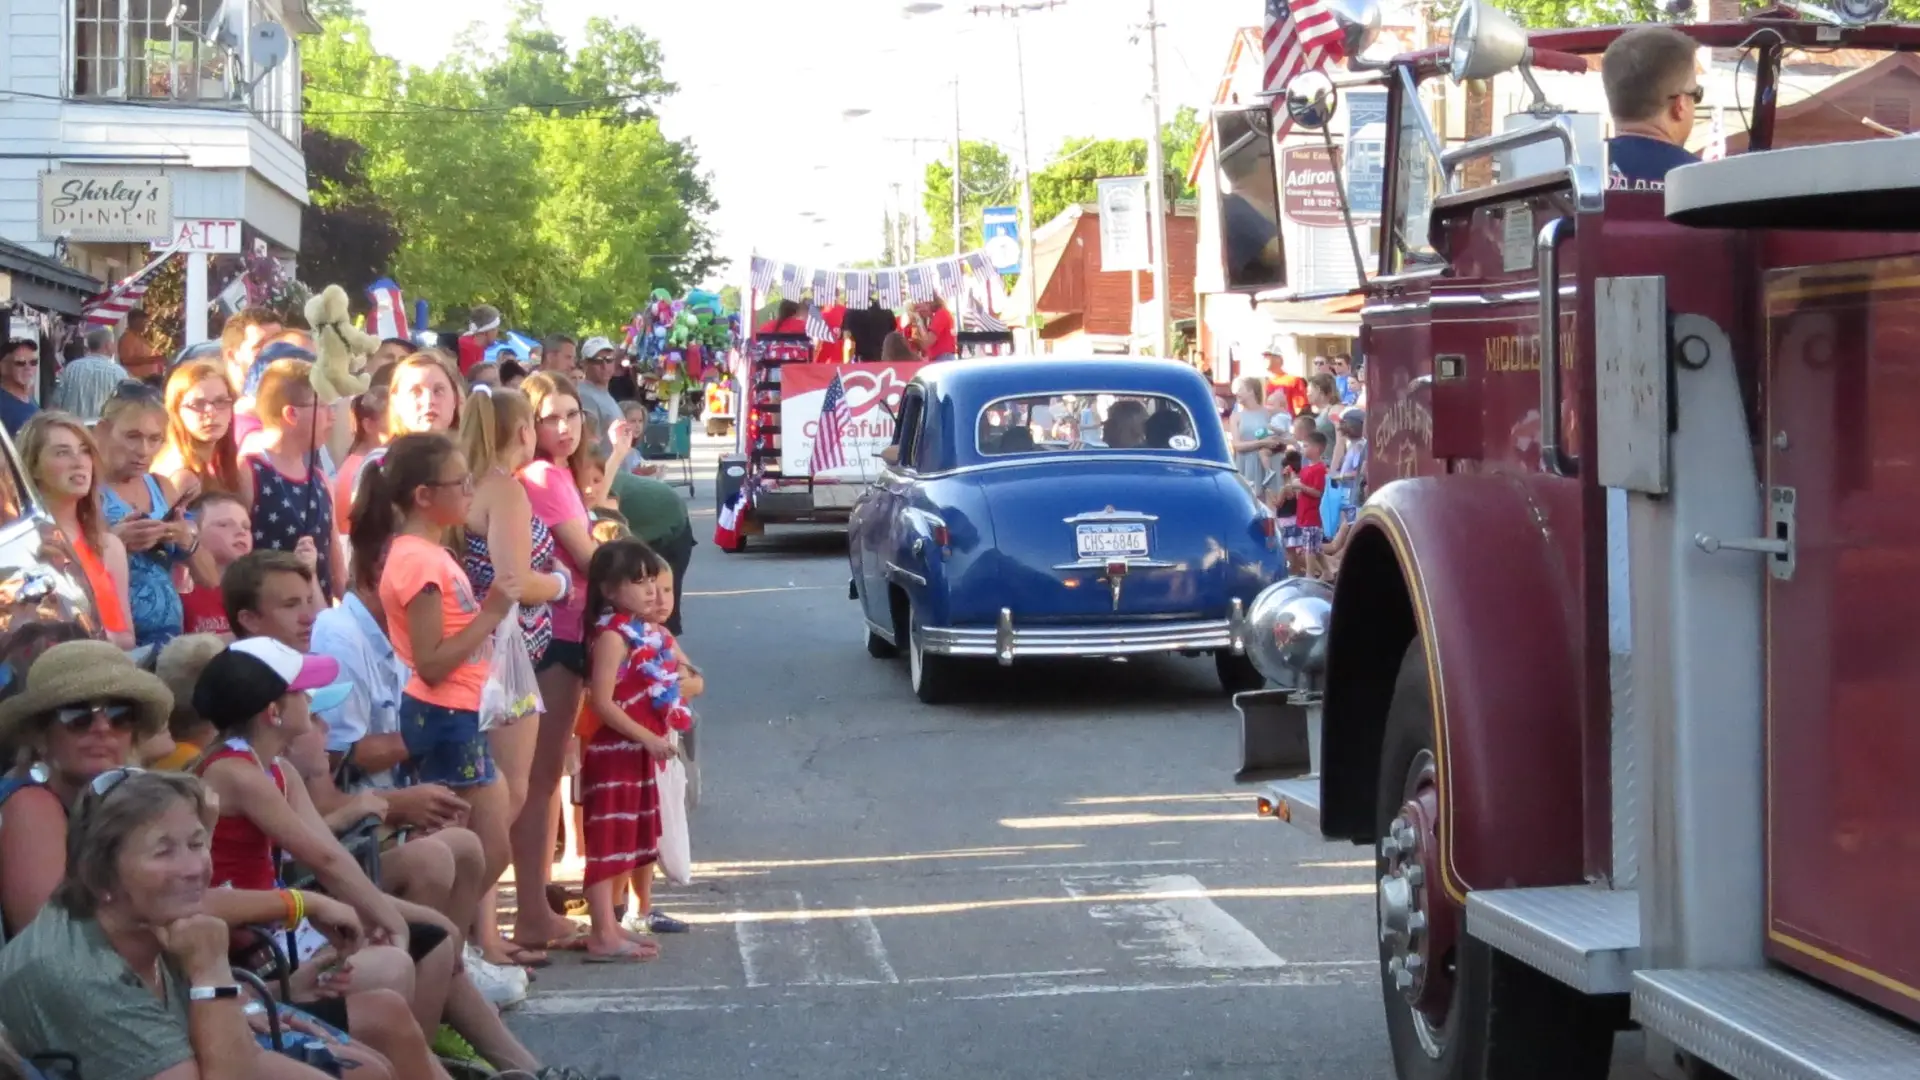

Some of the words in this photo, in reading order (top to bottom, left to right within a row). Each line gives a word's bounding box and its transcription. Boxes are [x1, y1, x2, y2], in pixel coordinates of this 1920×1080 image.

[1285, 168, 1335, 188] Adiron
[51, 179, 159, 212] Shirley's
[151, 220, 236, 249] AIT
[802, 418, 894, 438] Csafull
